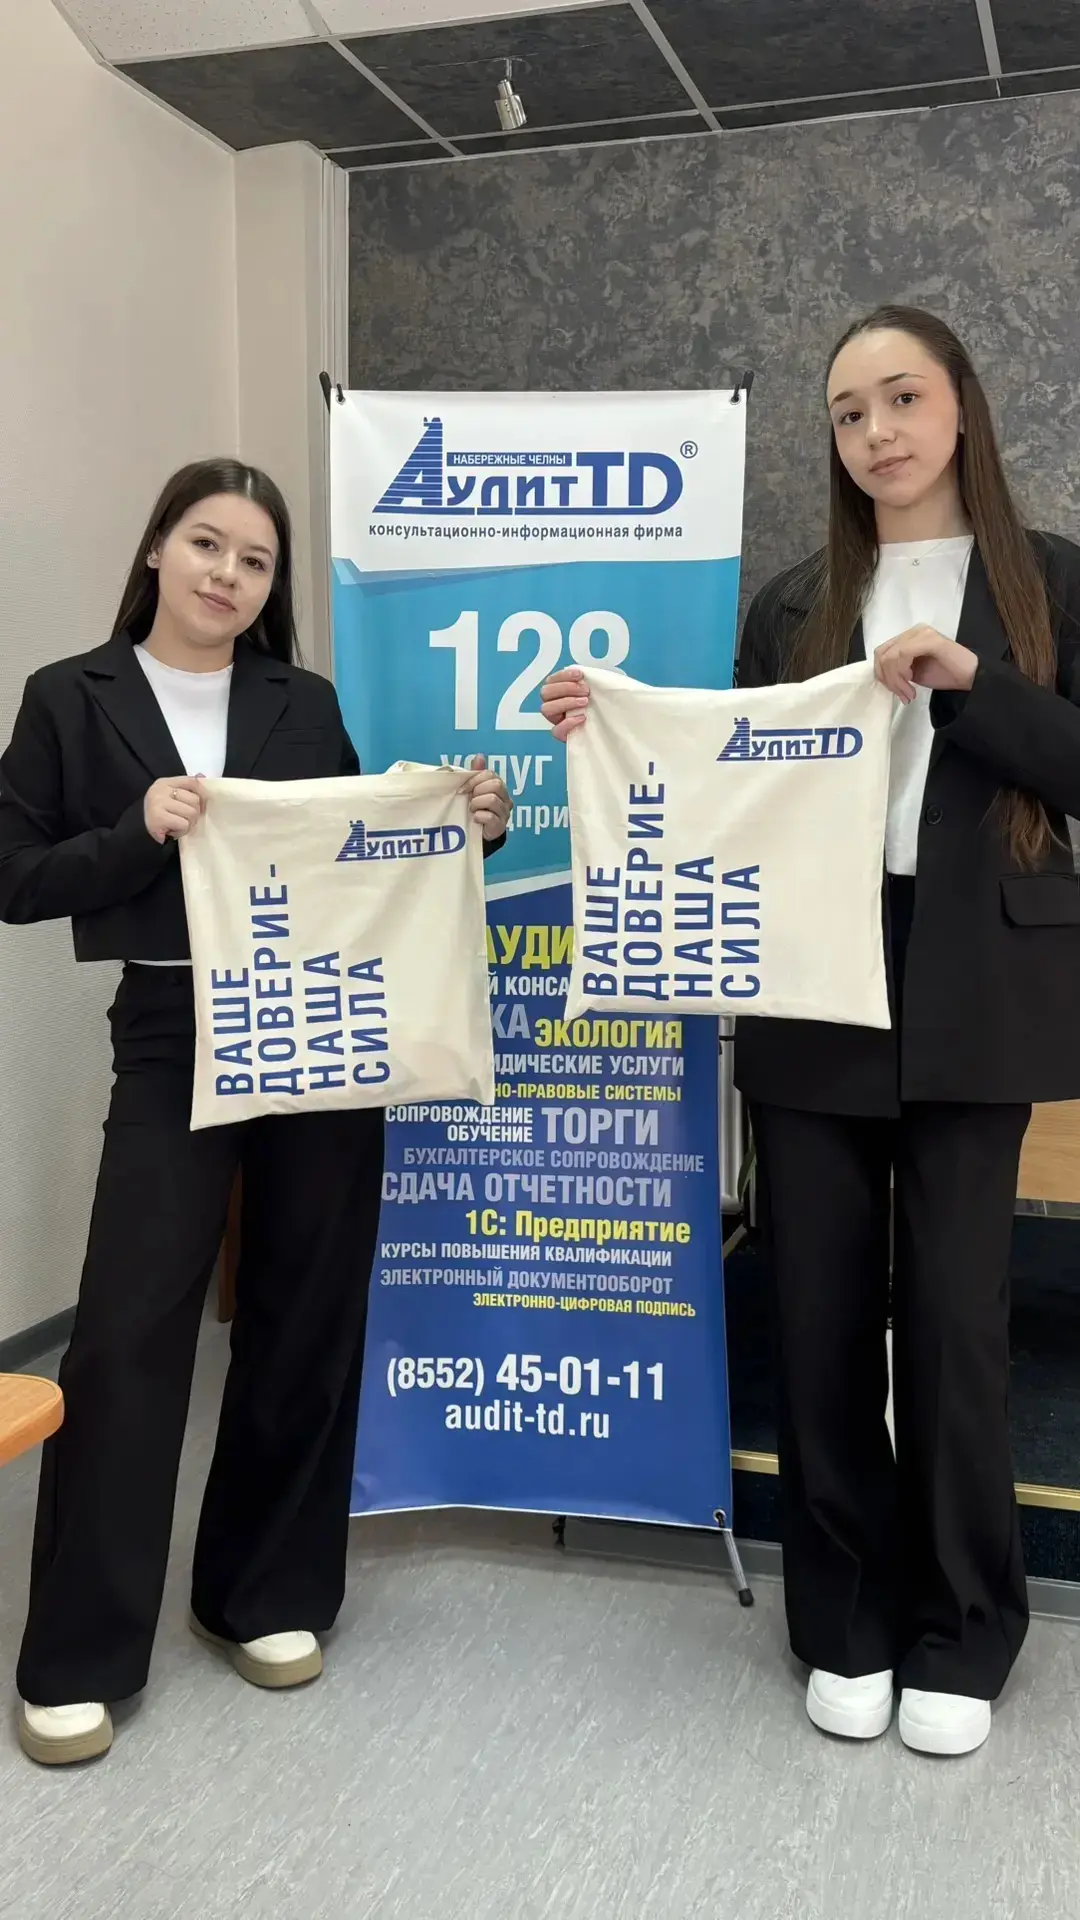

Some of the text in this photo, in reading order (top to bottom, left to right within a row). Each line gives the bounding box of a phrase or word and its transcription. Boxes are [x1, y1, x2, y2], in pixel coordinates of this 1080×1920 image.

[453, 453, 566, 466] НАБЕРЕЖНЫЕ ЧЕЛНЫ
[369, 524, 683, 541] консультационно-информационная фирма
[582, 865, 621, 997] ВАШЕ
[674, 856, 715, 998] НАША
[720, 864, 761, 998] СИЛА
[505, 976, 569, 996] КОНСА
[211, 967, 254, 1096] ВАШЕ
[303, 951, 346, 1091] НАША
[347, 957, 391, 1085] СИЛА
[534, 1018, 683, 1049] ЭКОЛОГИЯ
[611, 1055, 684, 1077] УСЛУГИ
[605, 1084, 681, 1102] СИСТЕМЫ
[385, 1106, 533, 1124] СОПРОВОЖДЕНИЕ
[541, 1107, 659, 1146] ТОРГИ
[447, 1125, 533, 1143] ОБУЧЕНИЕ
[403, 1148, 704, 1173] БУХГАЛТЕРСКОЕ СОПРОВОЖДЕНИЕ
[381, 1172, 671, 1207] СДАЧА ОТЧЕТНОСТИ
[515, 1210, 691, 1245] Предприятие
[381, 1243, 672, 1267] КУРСЫ ПОВЫШЕНИЯ КВАЛИФИКАЦИИ
[380, 1266, 673, 1295] ЭЛЕКТРОННЫЙ ДОКУМЕНТООБОРОТ
[473, 1293, 696, 1317] ЭЛЕКТРОННО-ЦИФРОВАЯ ПОДПИСЬ
[386, 1354, 664, 1400] (8552) 45-01-11
[445, 1400, 610, 1439] audit-td.ru
